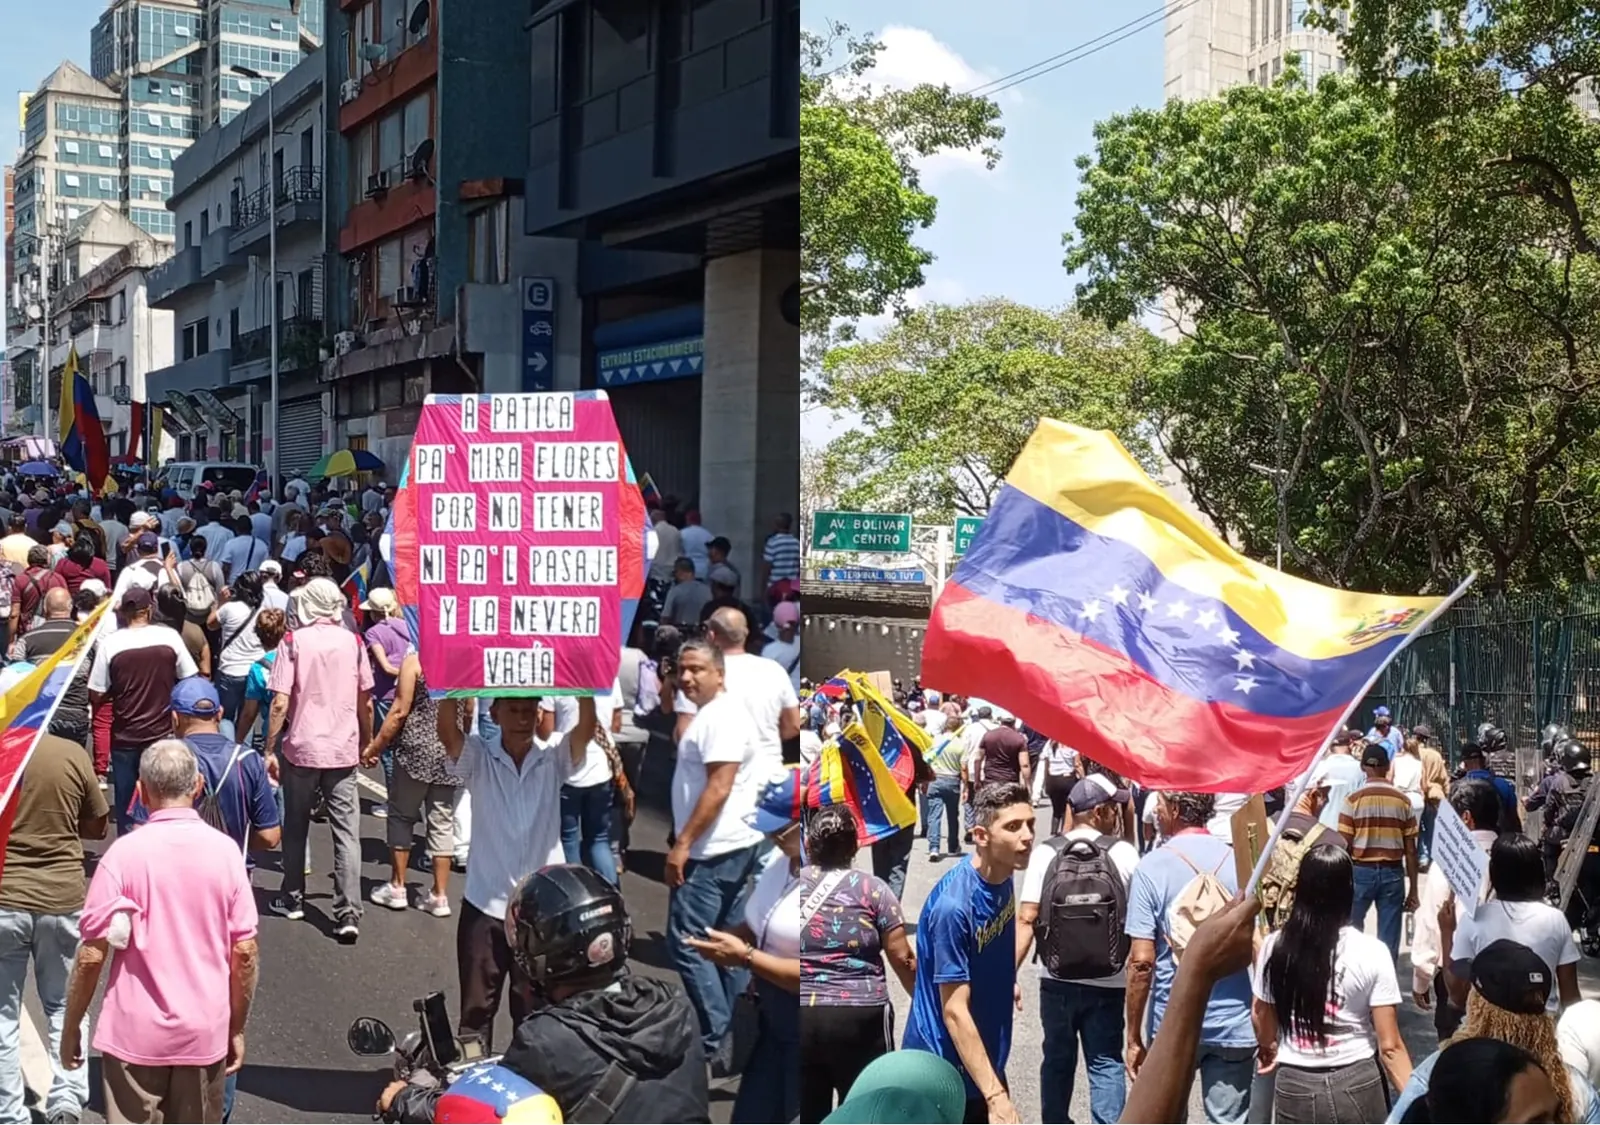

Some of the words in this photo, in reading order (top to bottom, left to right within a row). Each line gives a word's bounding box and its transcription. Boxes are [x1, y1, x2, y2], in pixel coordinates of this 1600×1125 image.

[532, 286, 546, 302] E
[600, 352, 632, 369] ENTRADA
[464, 397, 477, 430] A
[493, 395, 572, 429] PATICA
[418, 445, 453, 480] PA'
[471, 446, 520, 480] MIRA
[537, 445, 616, 479] FLORES
[435, 496, 474, 529] POR
[492, 496, 519, 529] NO
[537, 495, 601, 529] TENER
[830, 519, 845, 529] AV.
[853, 519, 905, 531] BOLIVAR
[852, 533, 900, 545] CENTRO
[423, 548, 442, 581] NI
[532, 549, 615, 583] PASAJE
[843, 571, 881, 580] TERMINAL
[899, 571, 915, 580] TUY
[443, 598, 455, 632] Y
[472, 599, 496, 632] LA
[514, 599, 597, 633] NEVERA
[487, 642, 553, 685] VACÍA
[807, 883, 832, 911] LOLA
